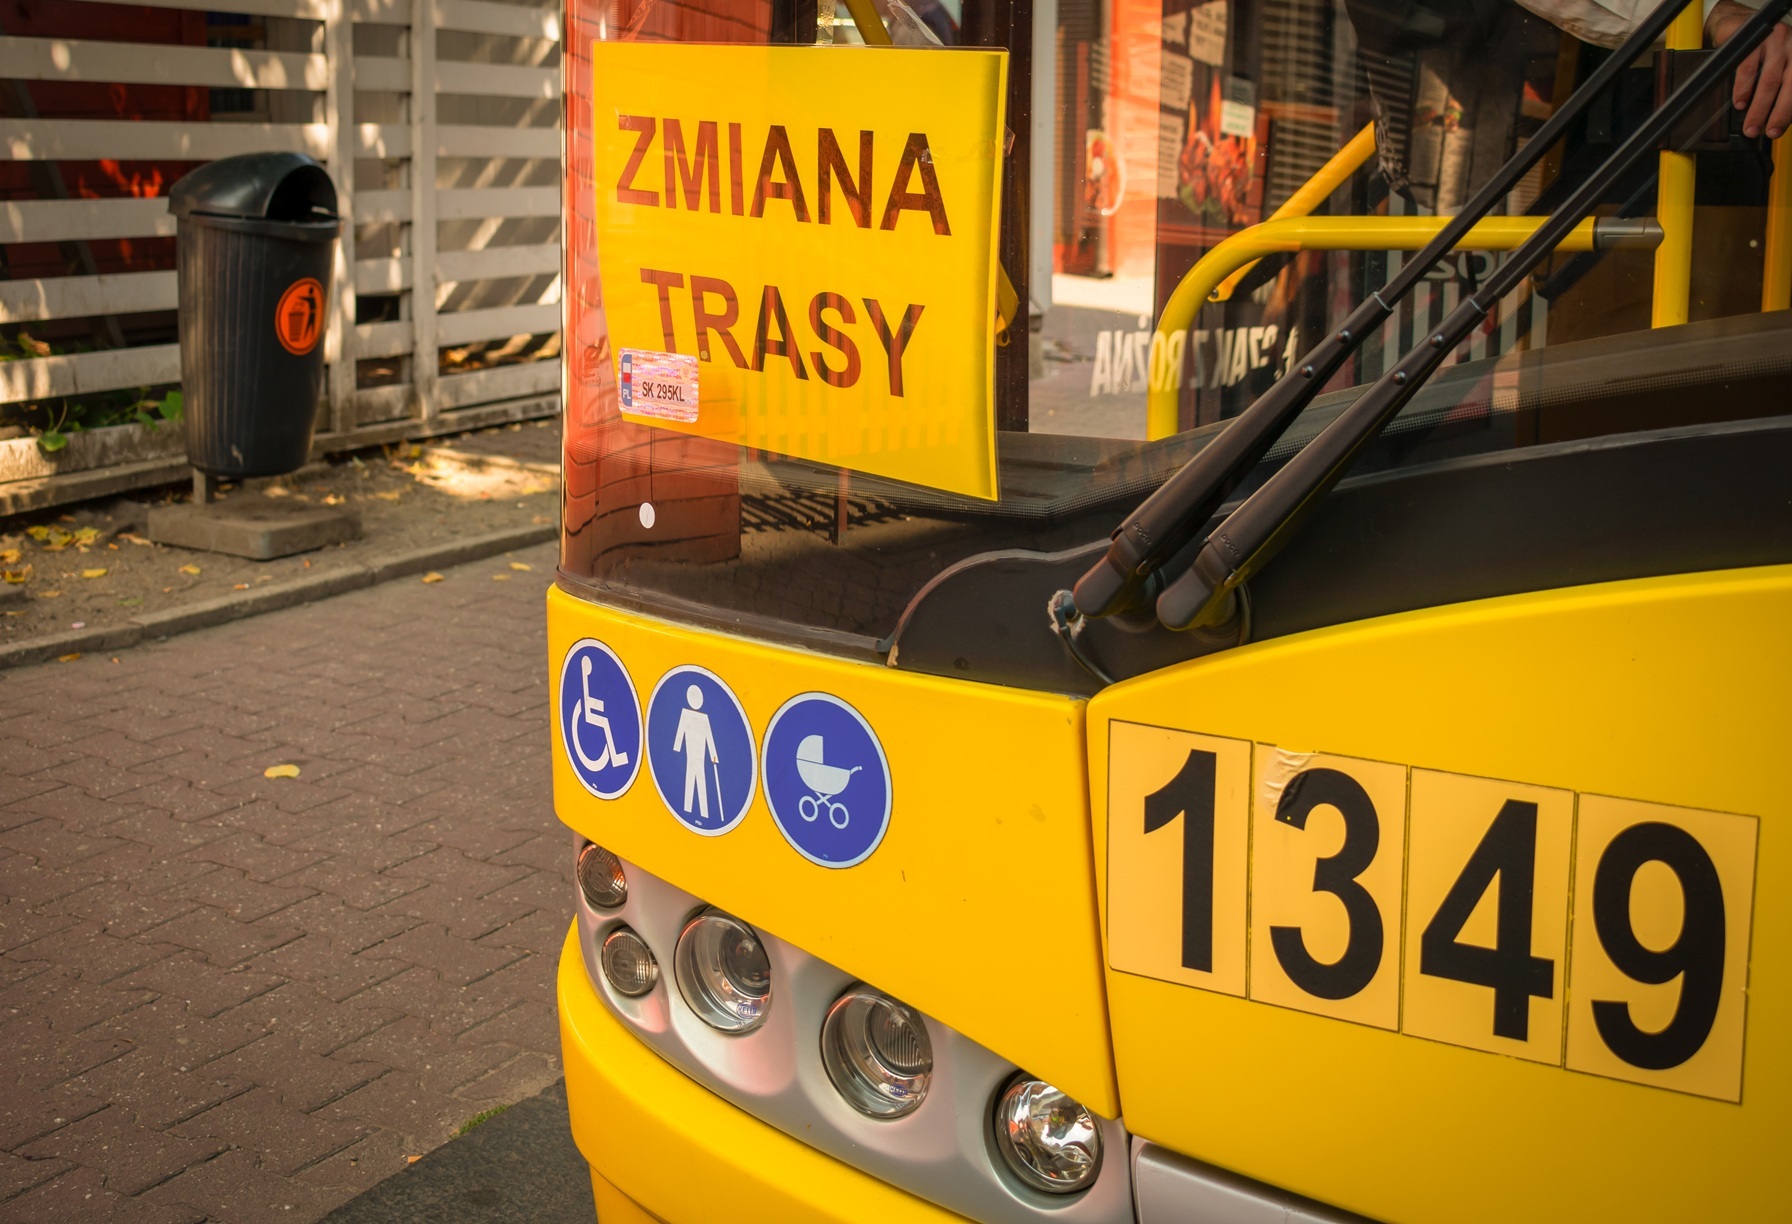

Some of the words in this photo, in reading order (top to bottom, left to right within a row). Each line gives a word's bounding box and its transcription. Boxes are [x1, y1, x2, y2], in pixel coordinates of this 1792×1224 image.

[617, 115, 952, 236] ZMIANA
[640, 268, 925, 397] TRASY
[642, 381, 654, 398] SK
[656, 384, 685, 402] 295KL
[622, 388, 631, 400] PL
[1143, 749, 1726, 1070] 1349
